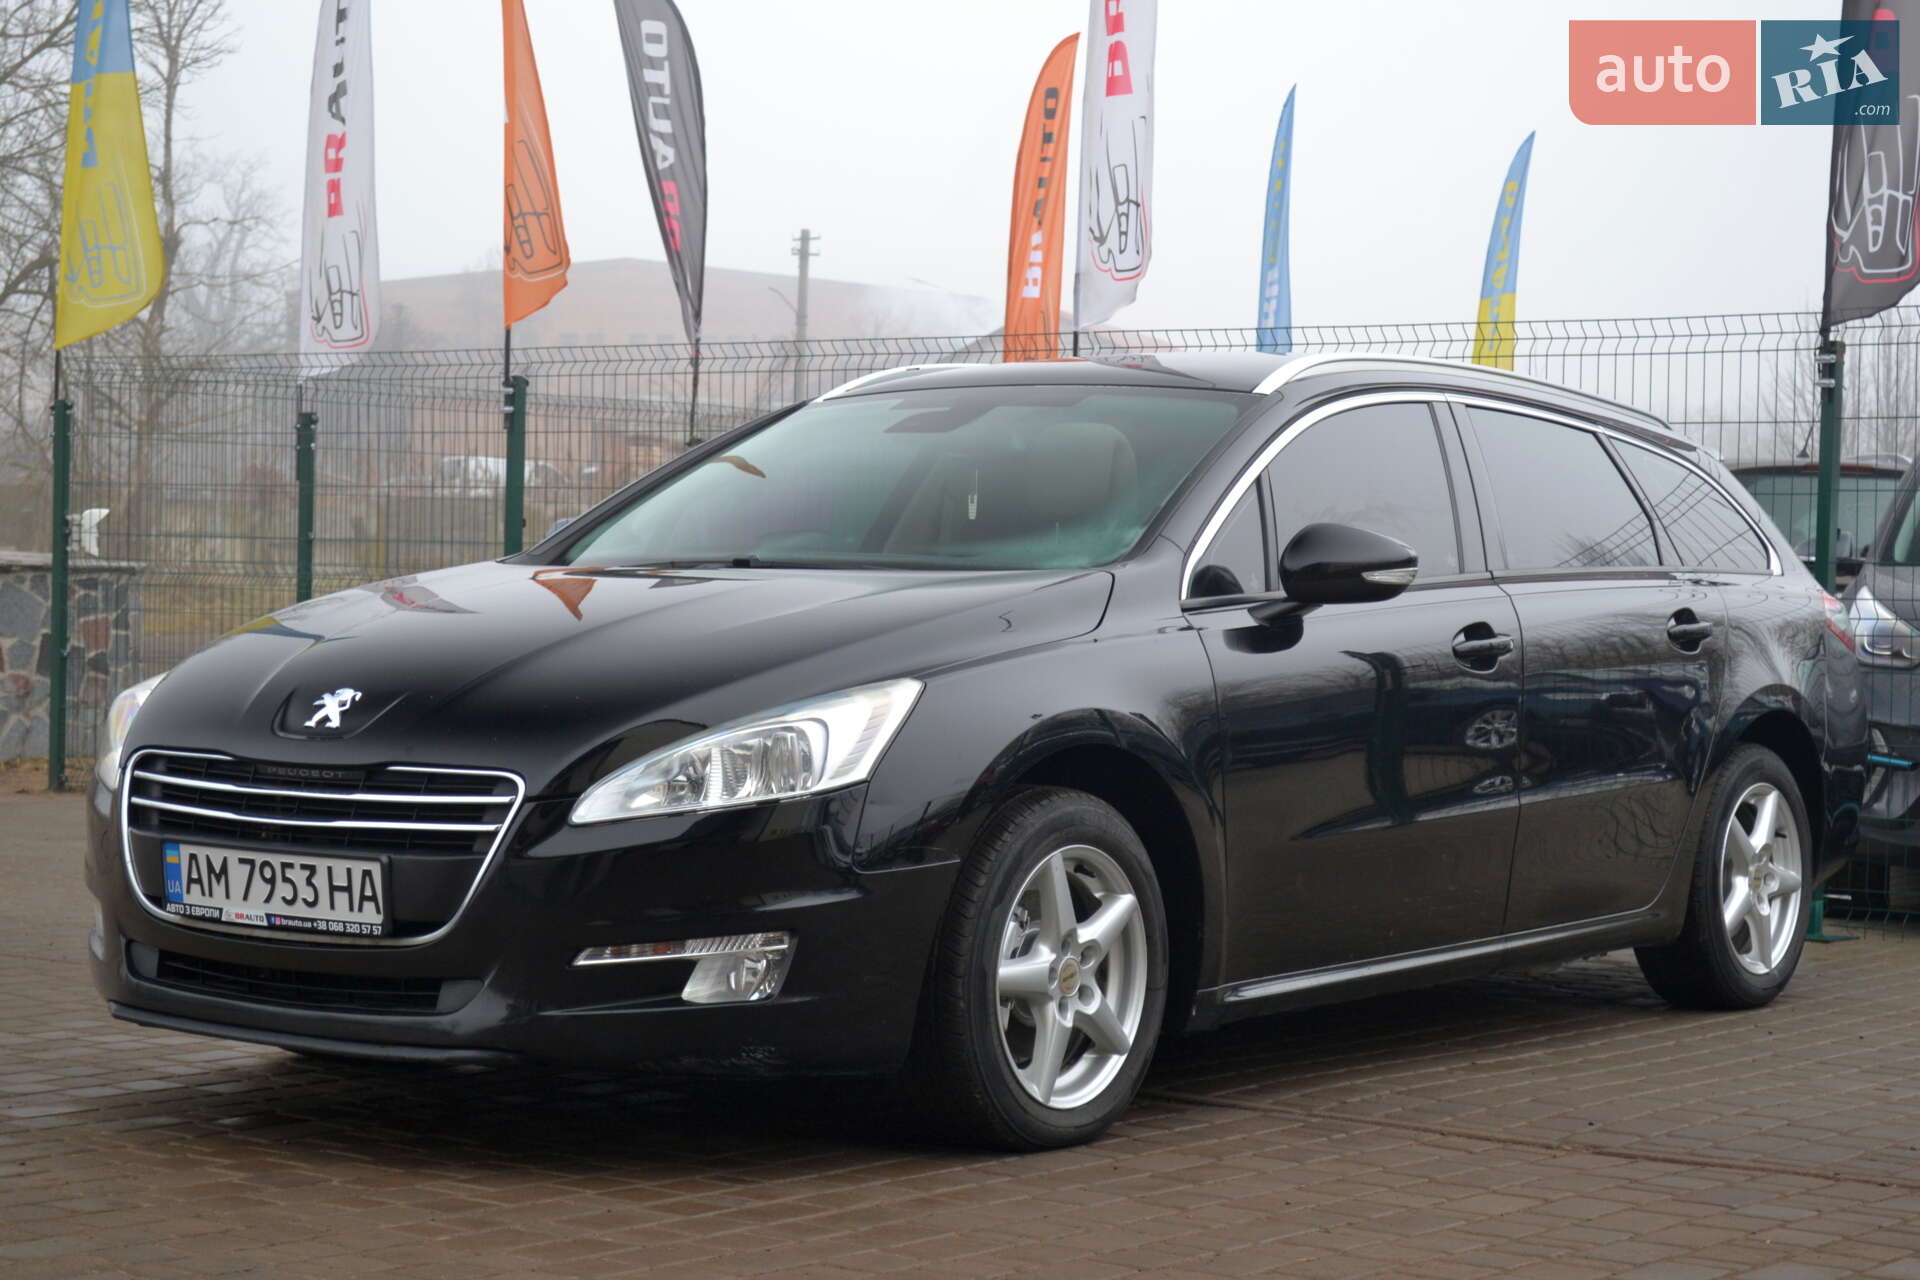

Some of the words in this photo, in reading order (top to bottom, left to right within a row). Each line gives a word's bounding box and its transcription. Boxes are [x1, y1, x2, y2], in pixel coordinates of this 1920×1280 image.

[267, 767, 344, 778] PEUGEOT
[167, 879, 182, 894] UA
[185, 853, 230, 900] AM
[238, 857, 319, 908] 7953
[327, 865, 382, 915] HA
[166, 904, 185, 914] АВТО
[345, 923, 360, 934] 320
[361, 925, 371, 934] 57
[372, 926, 382, 935] 57
